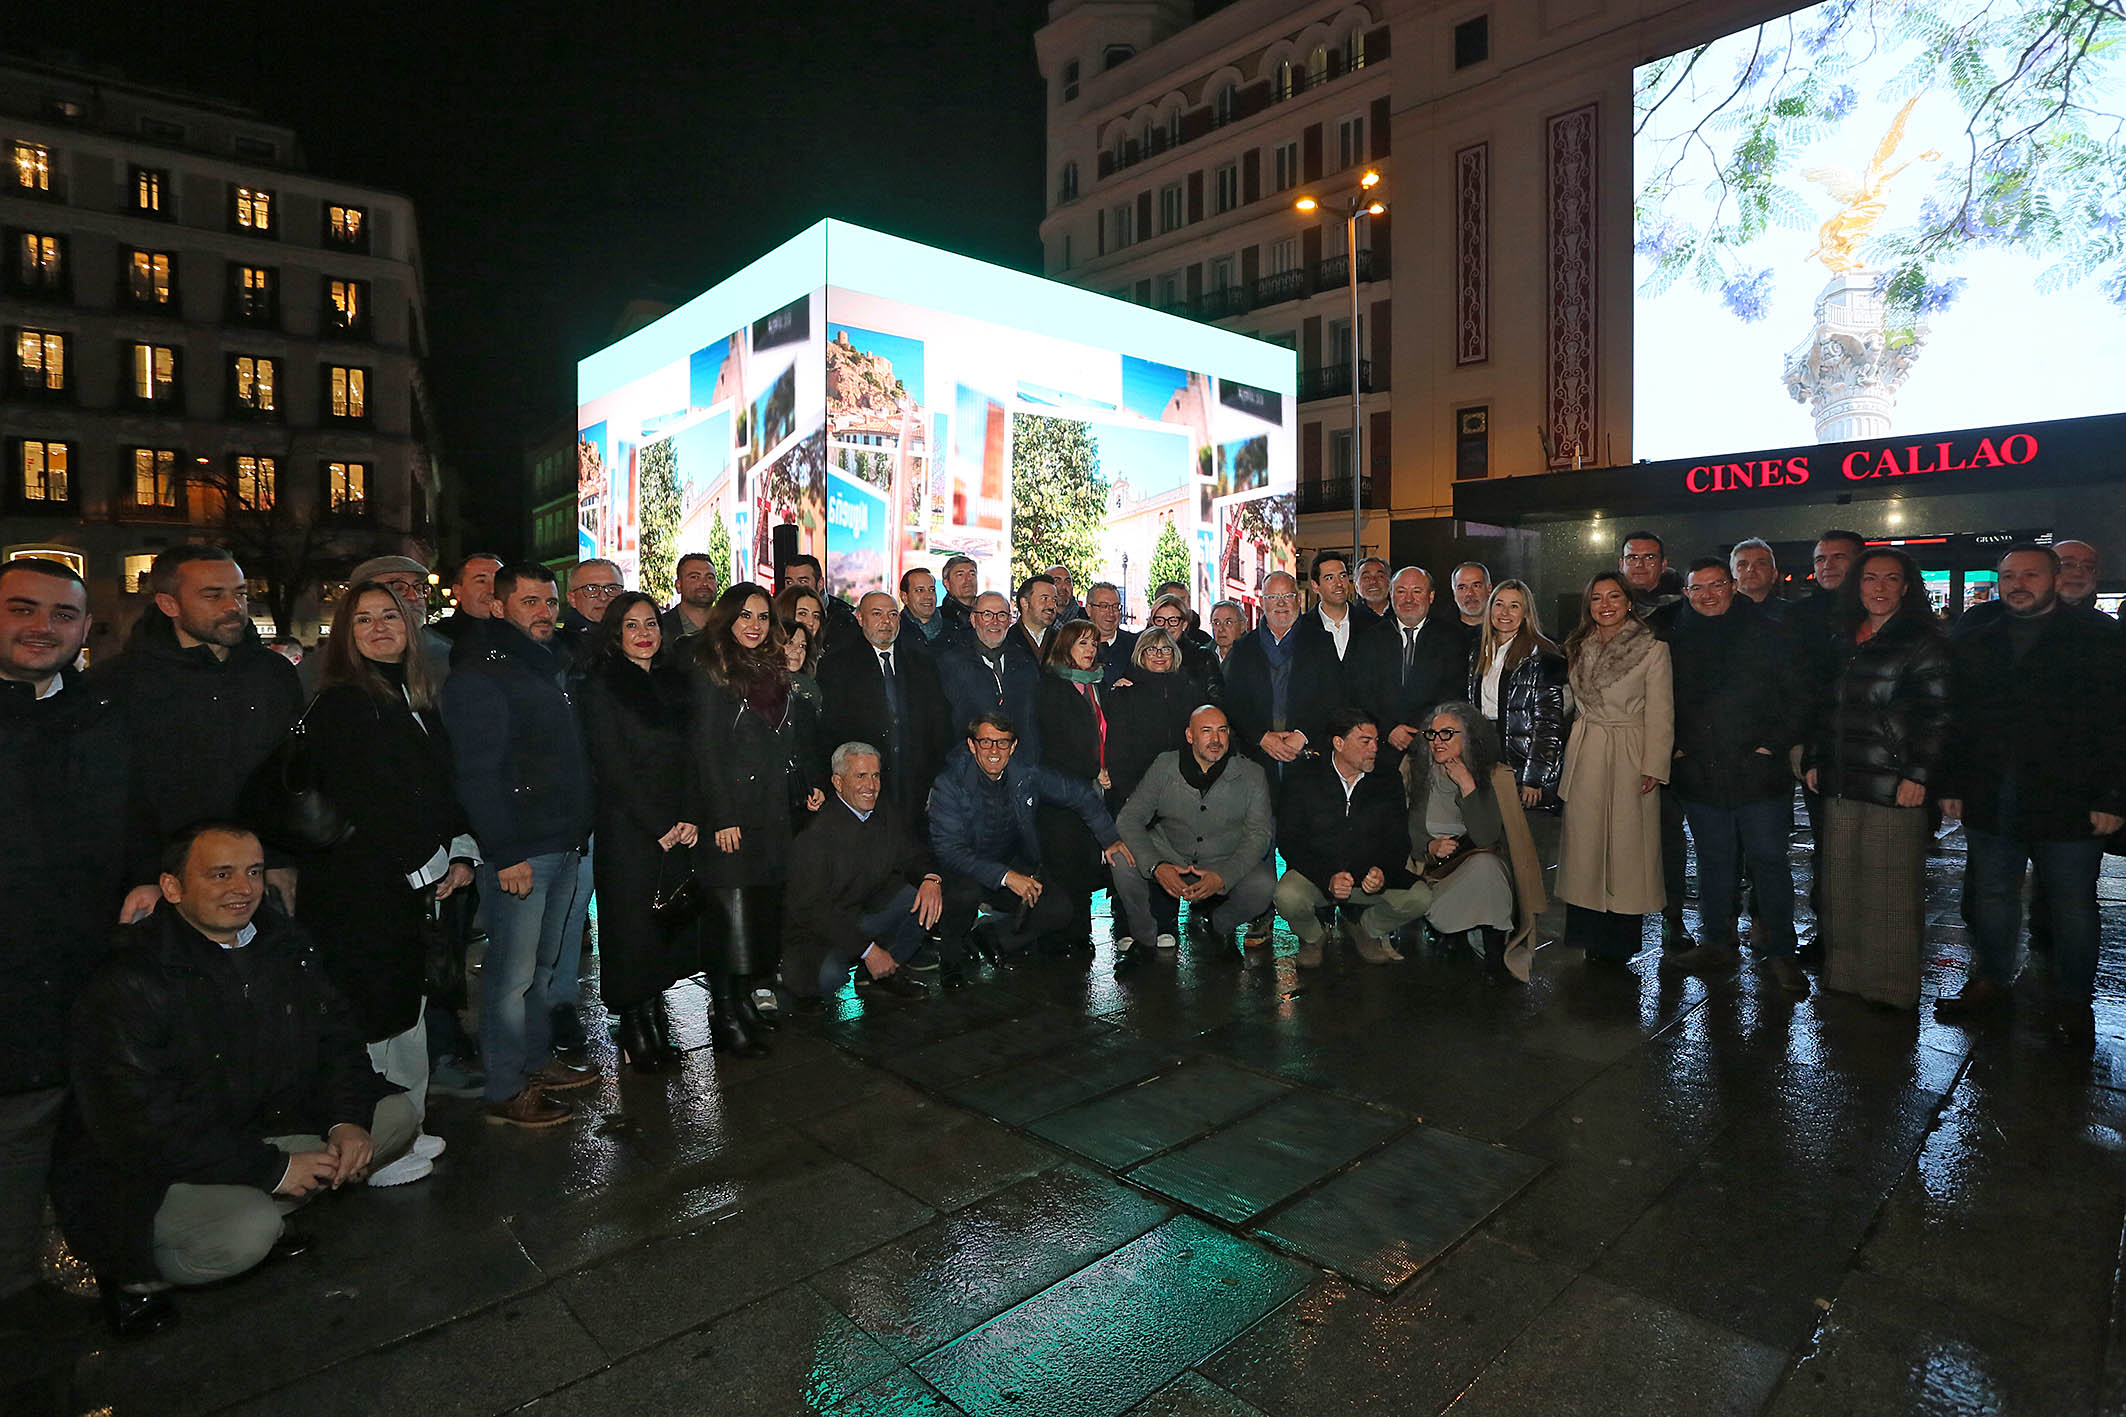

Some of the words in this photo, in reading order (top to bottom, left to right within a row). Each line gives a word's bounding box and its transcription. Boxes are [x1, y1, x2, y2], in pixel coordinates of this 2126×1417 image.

[1685, 456, 1811, 494] CINES
[1841, 433, 2039, 481] CALLAO
[1975, 535, 2000, 543] GRAN
